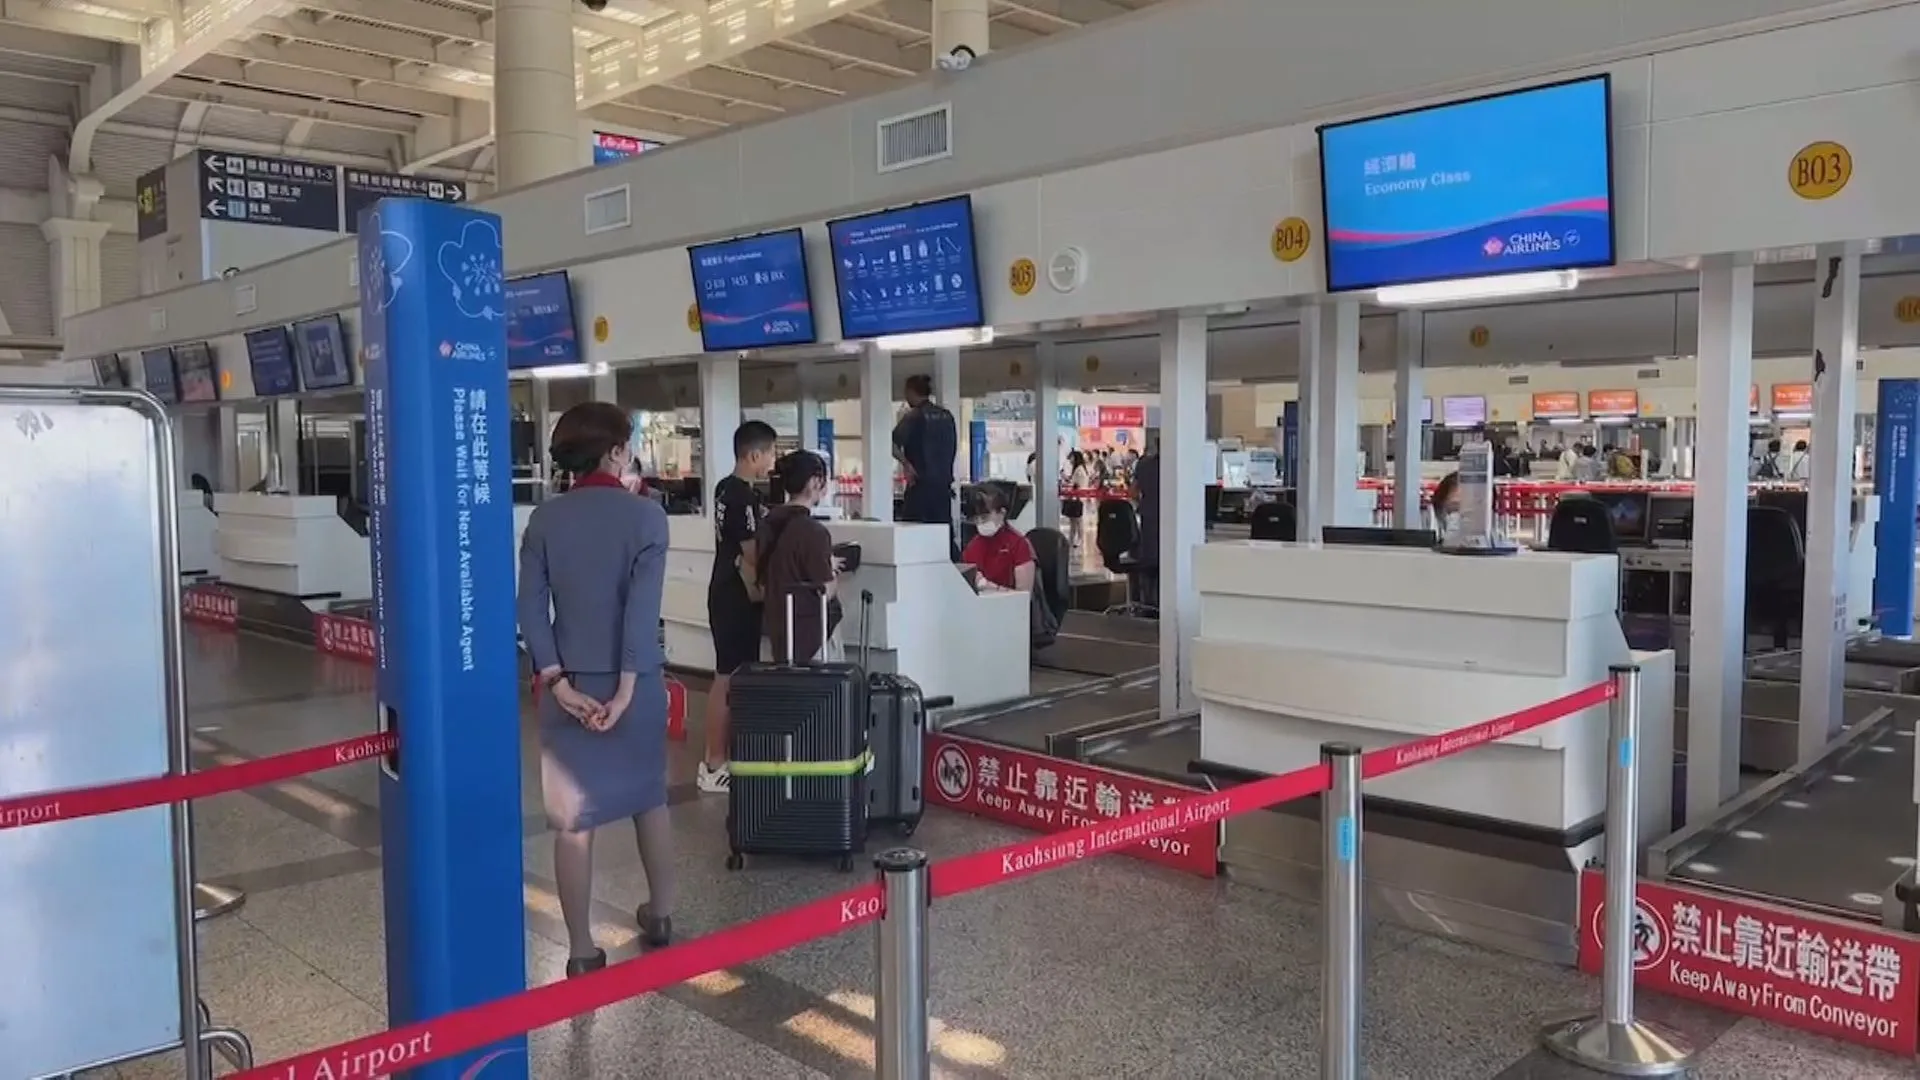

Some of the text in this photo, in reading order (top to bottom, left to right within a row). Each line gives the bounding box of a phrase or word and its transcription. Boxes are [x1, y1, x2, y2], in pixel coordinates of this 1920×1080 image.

[1365, 170, 1470, 196] Economy Class
[1797, 153, 1841, 187] B03
[1275, 225, 1304, 252] B04
[1503, 239, 1561, 255] AIRLINES
[1510, 231, 1552, 244] CHINA
[1011, 266, 1033, 286] B05
[452, 350, 486, 361] AIRLINES
[455, 341, 480, 351] CHINA
[470, 389, 490, 504] 請在此等候
[453, 387, 474, 671] Please Wait for Next Available Agent
[334, 736, 399, 762] Kaohsiu
[977, 788, 1011, 810] Keep
[1017, 799, 1054, 822] Away
[1002, 798, 1231, 876] Kaohsiung International Airport
[1671, 901, 1900, 1001] 禁止靠近輸送帶
[1669, 960, 1899, 1038] Keep Away From Conveyor
[314, 1030, 433, 1080] Airport
